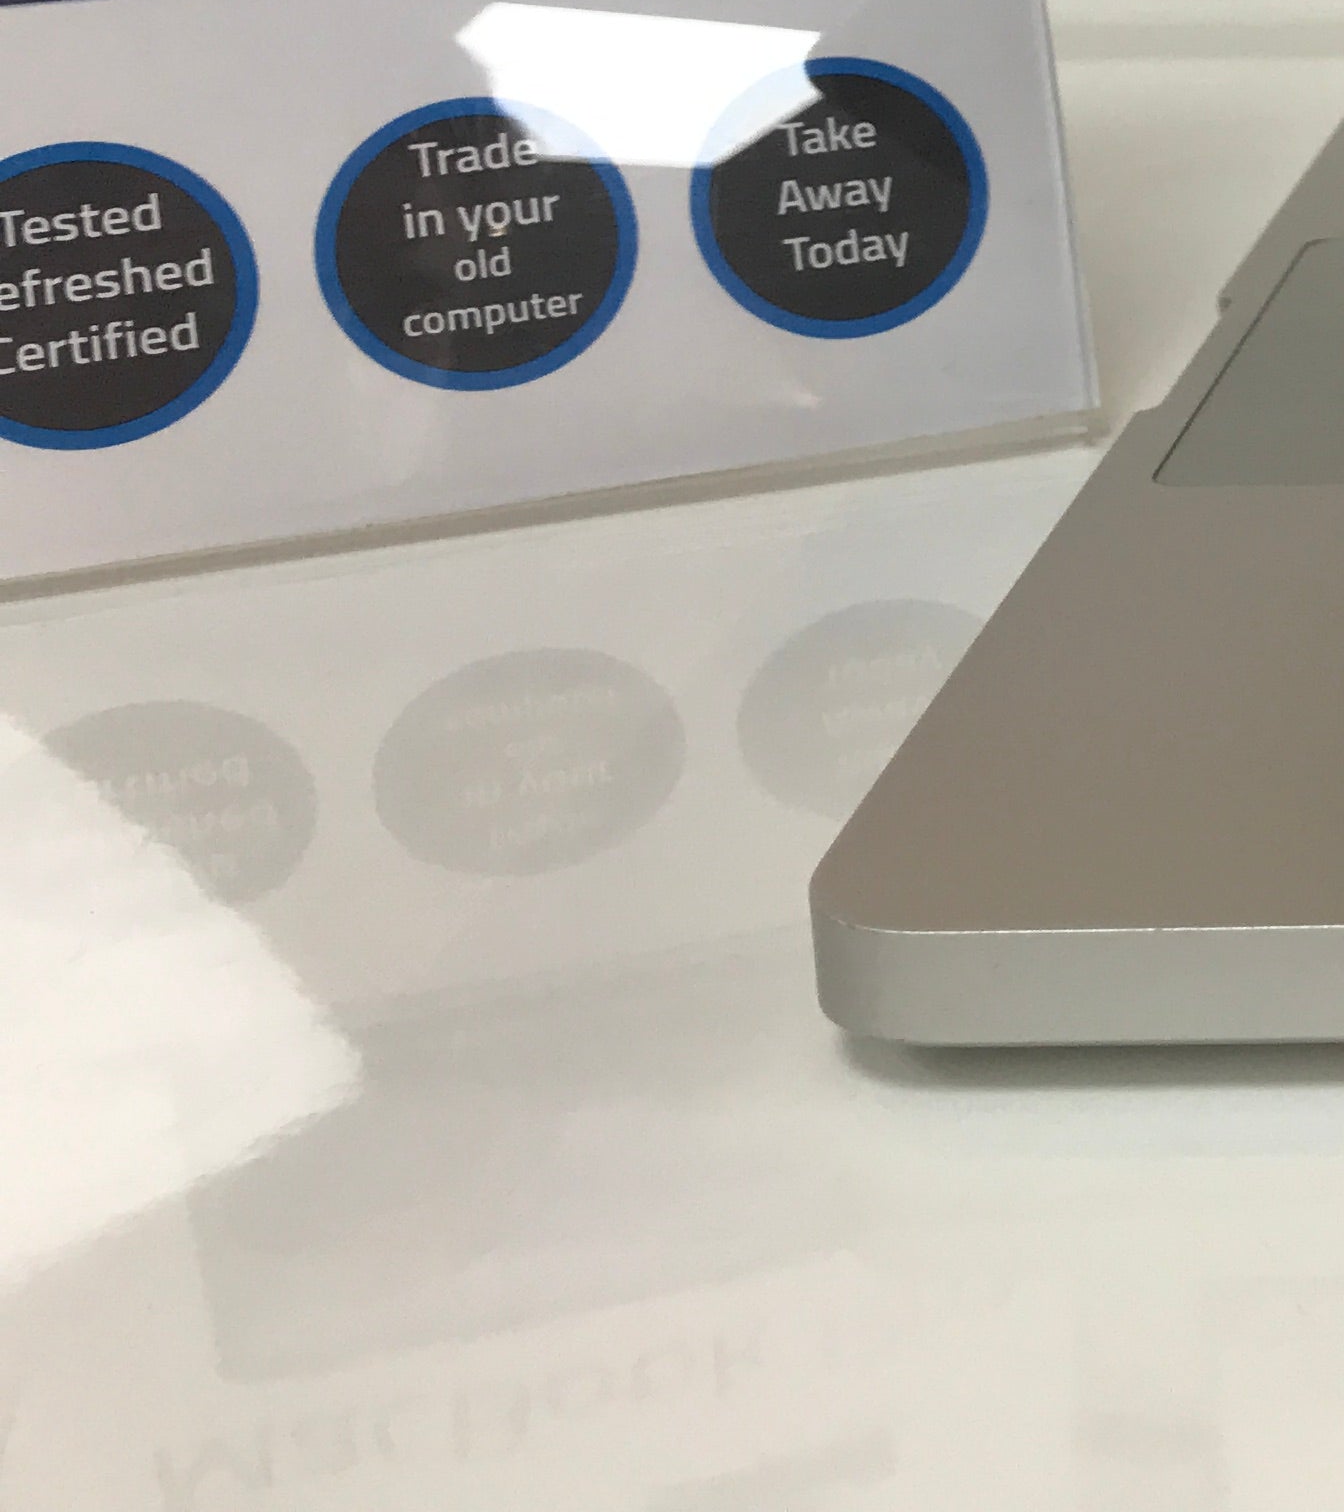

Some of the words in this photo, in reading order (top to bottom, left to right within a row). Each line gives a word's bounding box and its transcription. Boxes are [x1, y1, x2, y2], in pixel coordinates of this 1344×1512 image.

[407, 132, 541, 178] Trade
[774, 116, 878, 157] Take
[777, 176, 893, 216] Away
[0, 192, 162, 248] Tested
[403, 202, 446, 239] in
[456, 194, 561, 243] your
[454, 246, 513, 282] old
[782, 228, 910, 272] Today
[403, 292, 584, 337] computer
